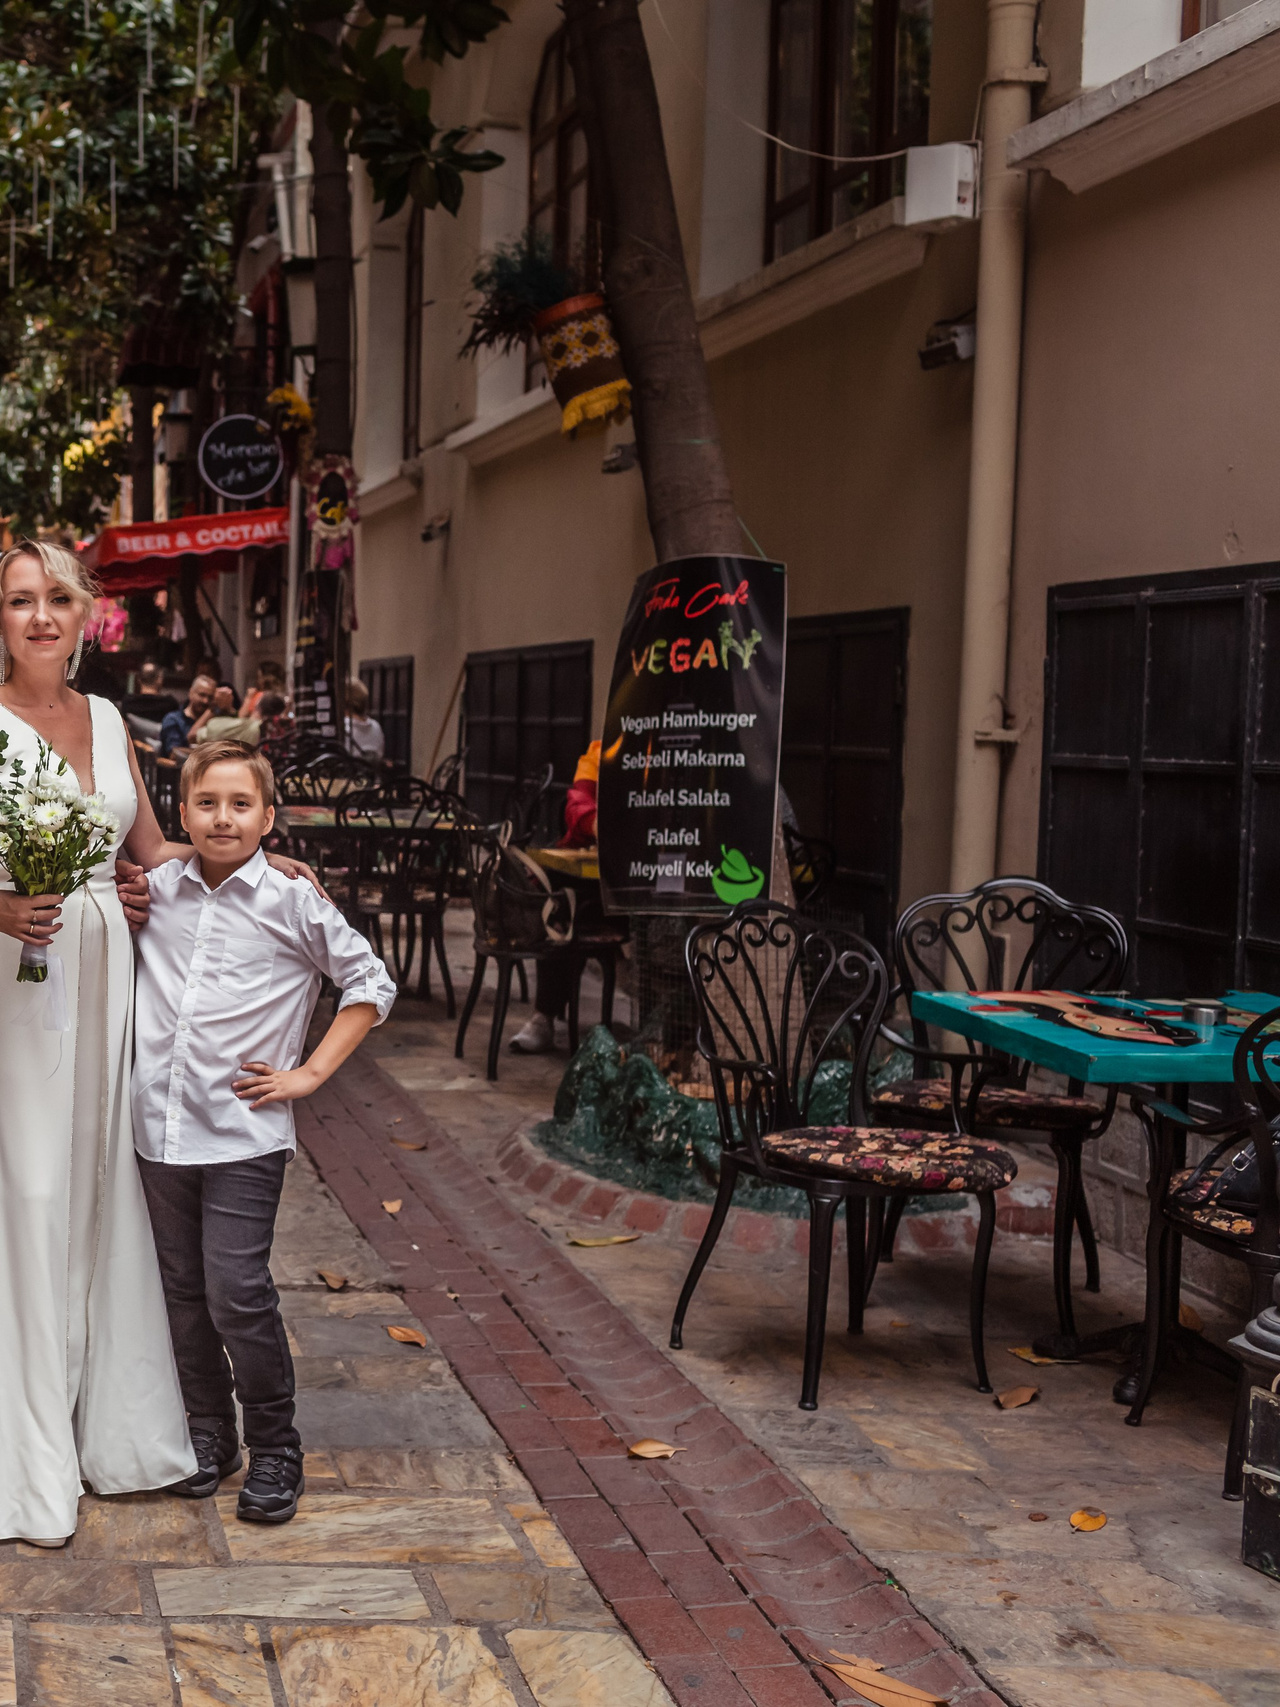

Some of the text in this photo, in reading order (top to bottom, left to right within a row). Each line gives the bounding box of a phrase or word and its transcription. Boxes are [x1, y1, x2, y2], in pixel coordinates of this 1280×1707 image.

[116, 534, 171, 553] BEER
[175, 531, 192, 547] &
[631, 620, 762, 677] VEGAN
[621, 710, 757, 735] Vegan Hamburger
[622, 749, 745, 770] Sebzeli Makarna
[628, 789, 731, 808] Falafel Salata
[648, 828, 700, 846] Falafel
[630, 860, 714, 880] Meyveli Kek
